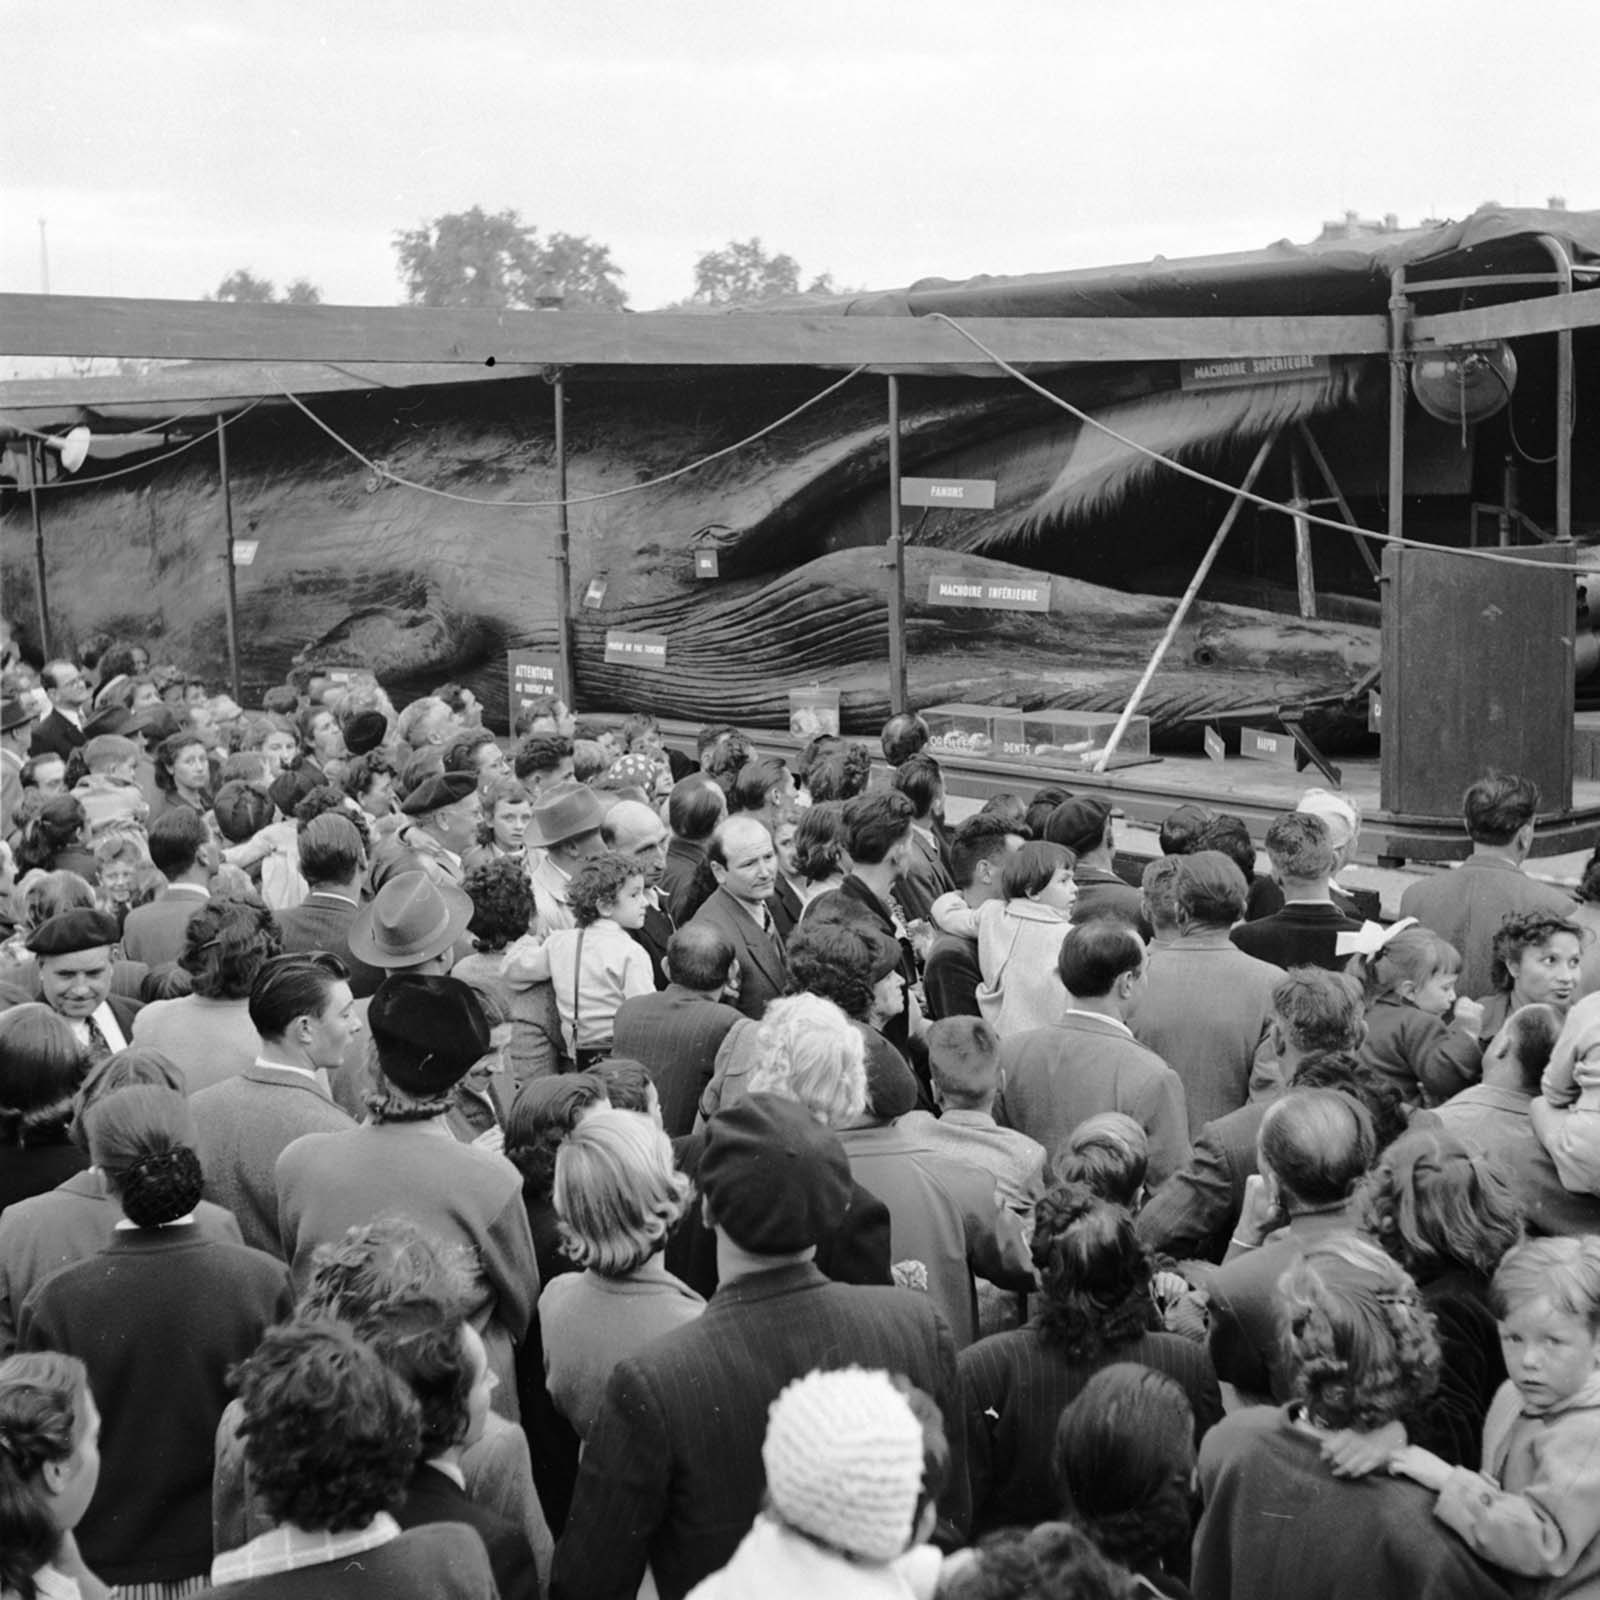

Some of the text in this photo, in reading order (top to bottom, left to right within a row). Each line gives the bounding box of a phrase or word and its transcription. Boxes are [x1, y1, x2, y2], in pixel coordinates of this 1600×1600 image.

[1195, 363, 1247, 379] MACHOIRE
[930, 485, 964, 498] FANONS
[939, 584, 983, 598] MACHOIRE
[515, 665, 553, 680] ATTENTION
[1004, 741, 1031, 755] DENTS
